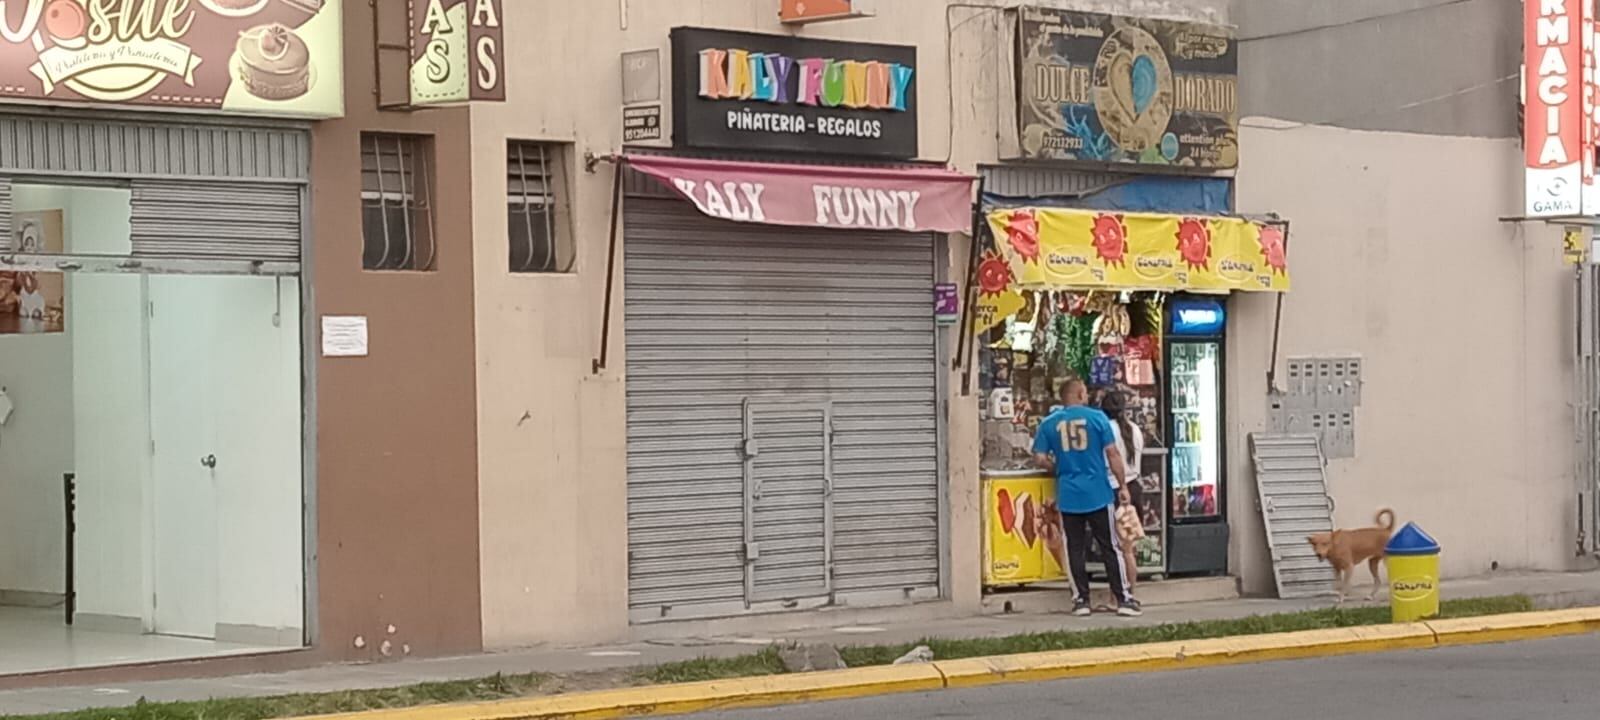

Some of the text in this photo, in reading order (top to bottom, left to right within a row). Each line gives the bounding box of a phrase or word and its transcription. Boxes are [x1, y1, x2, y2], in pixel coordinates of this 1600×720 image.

[698, 48, 913, 112] KALY FUNNY
[1036, 63, 1235, 113] DULCE DORADO
[727, 107, 806, 133] PIÑATERIA
[817, 116, 881, 138] REGALOS
[673, 177, 920, 229] KALY FUNNY
[1533, 201, 1573, 213] GAMA
[1056, 418, 1088, 451] 15
